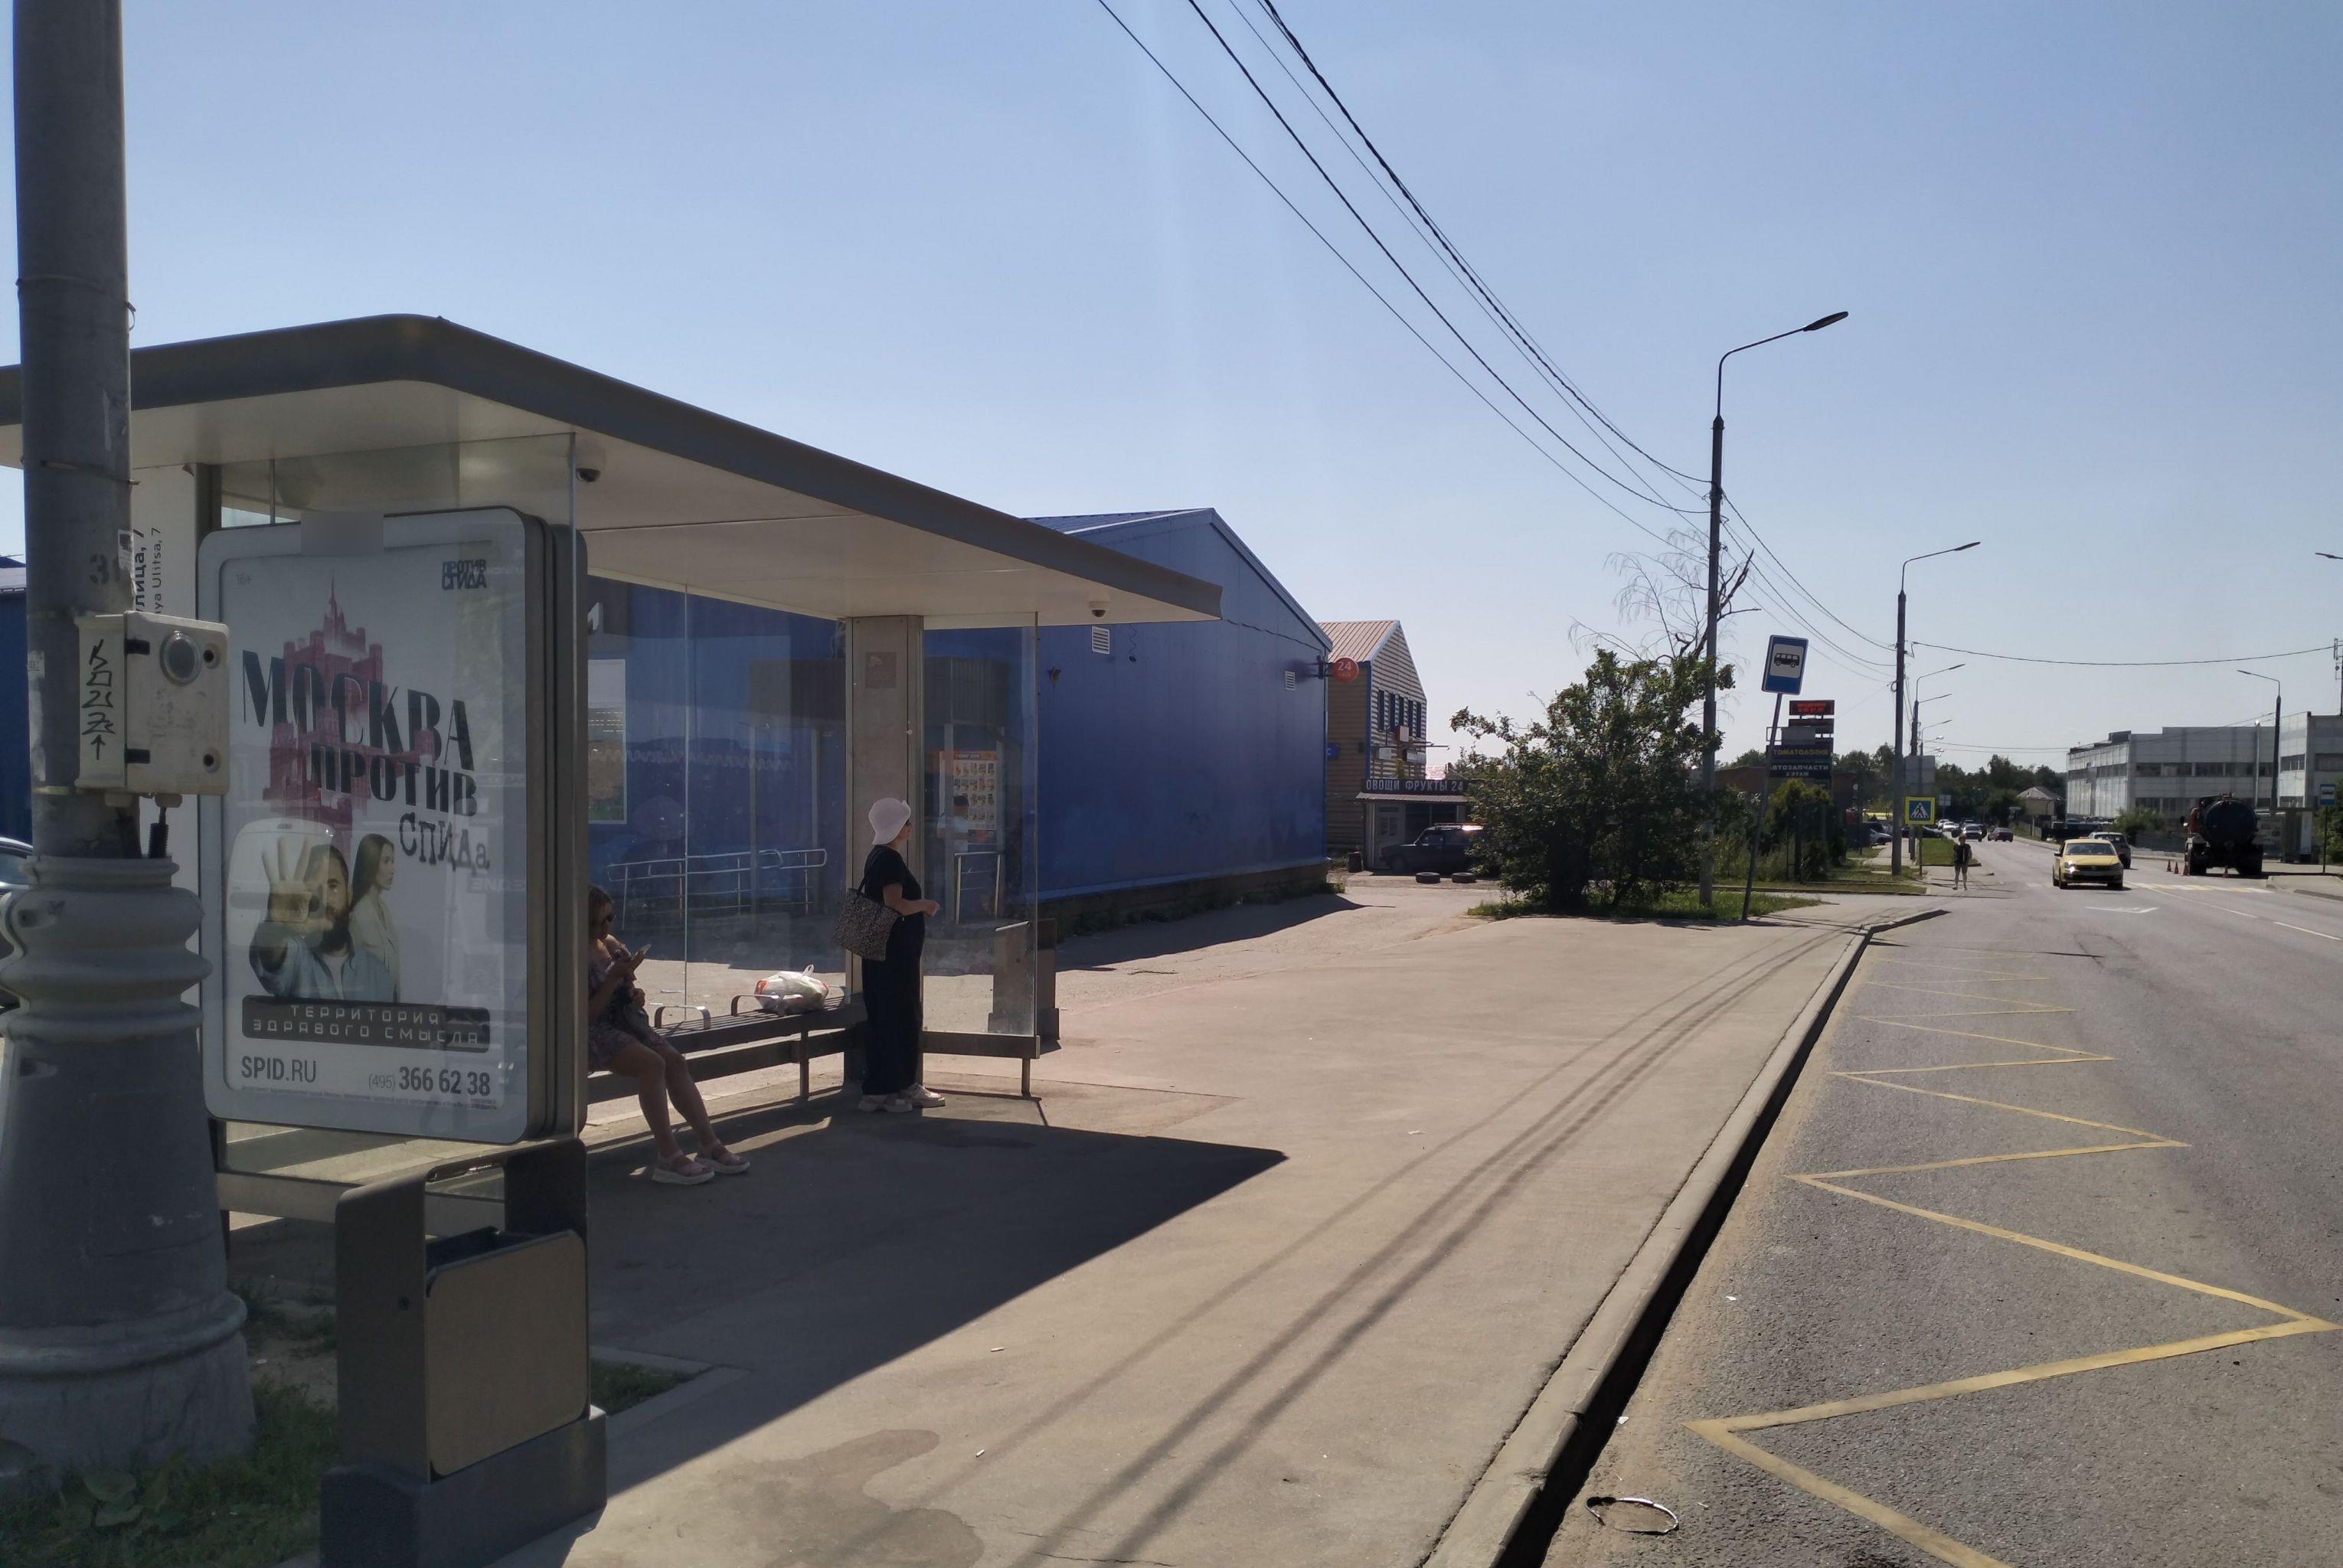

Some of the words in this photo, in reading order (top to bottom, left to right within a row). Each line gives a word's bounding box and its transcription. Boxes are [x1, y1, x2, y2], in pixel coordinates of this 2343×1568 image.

[151, 527, 162, 536] 7
[152, 540, 163, 589] Ulitsa,
[442, 559, 487, 576] ПРОТИВ
[441, 573, 487, 590] СПИДА
[1337, 661, 1352, 671] 24
[242, 649, 475, 771] МОСКВА
[310, 741, 478, 817] ПРОТИВ
[1366, 779, 1400, 791] ОВОЩИ
[1405, 780, 1448, 792] ФРУКТЫ
[1451, 781, 1464, 792] 24
[291, 1004, 440, 1026] ТЕРРИТОРИЯ
[253, 1019, 370, 1038] ЗДРАВОГО
[384, 1027, 479, 1044] СМЫСЛА
[241, 1056, 317, 1084] SPID.RU
[368, 1073, 396, 1093] (495)
[398, 1067, 434, 1093] 366
[439, 1069, 462, 1095] 62
[466, 1071, 492, 1097] 38
